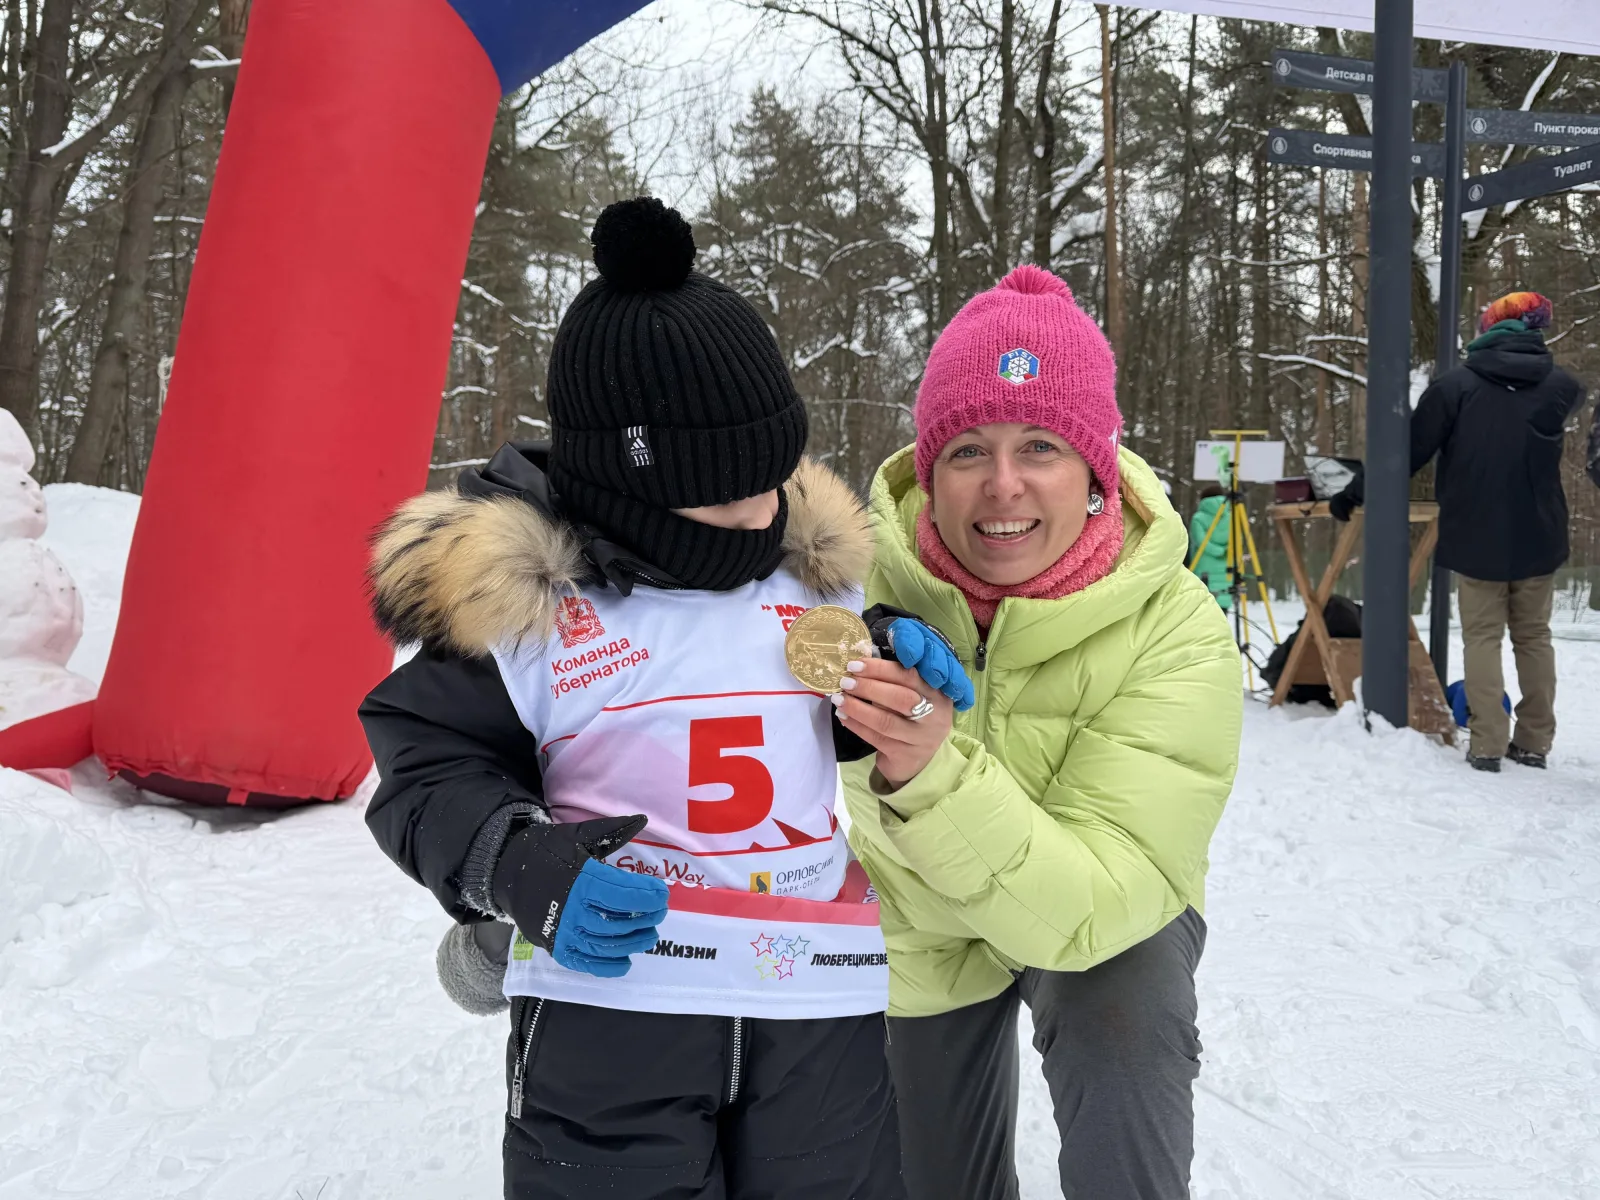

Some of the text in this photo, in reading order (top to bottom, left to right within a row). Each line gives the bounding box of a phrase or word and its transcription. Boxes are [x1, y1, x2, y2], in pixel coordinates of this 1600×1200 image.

[1325, 66, 1366, 82] Детская
[1534, 122, 1566, 135] Пункт
[1312, 143, 1373, 159] Спортивная
[1553, 160, 1593, 178] Туалет
[551, 637, 631, 676] Команда
[687, 715, 774, 834] 5
[616, 855, 660, 876] Silky
[662, 858, 705, 885] Way
